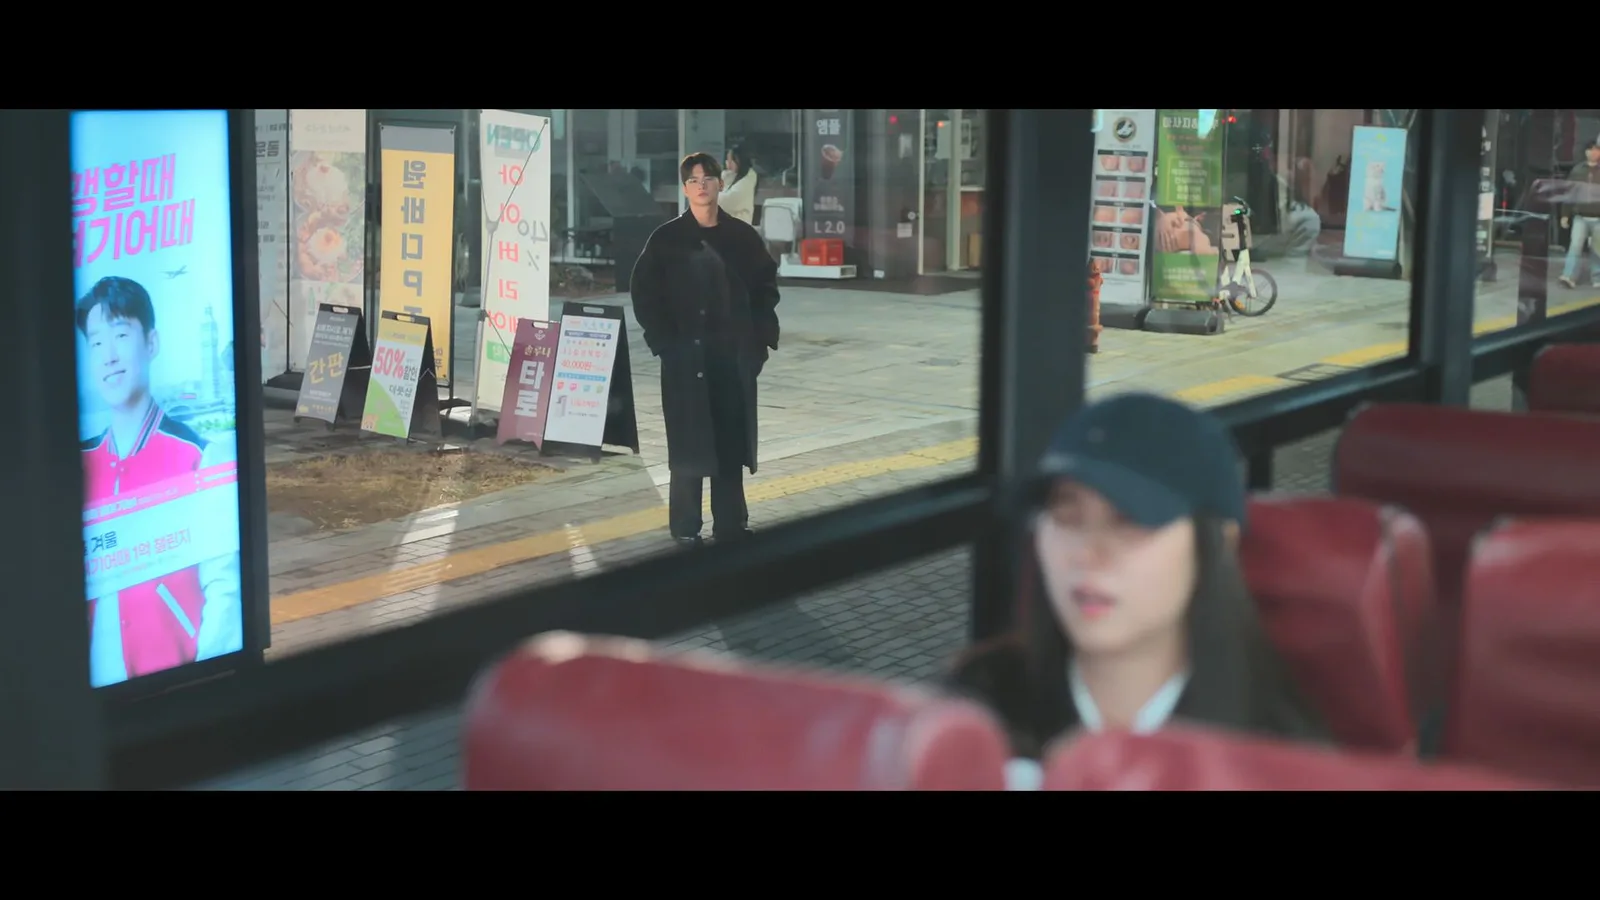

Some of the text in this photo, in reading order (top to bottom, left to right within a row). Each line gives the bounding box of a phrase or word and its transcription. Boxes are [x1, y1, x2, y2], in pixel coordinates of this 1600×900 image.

[308, 352, 345, 384] 간판
[373, 346, 406, 380] 50%
[514, 360, 545, 418] 타로
[91, 530, 118, 553] 겨울
